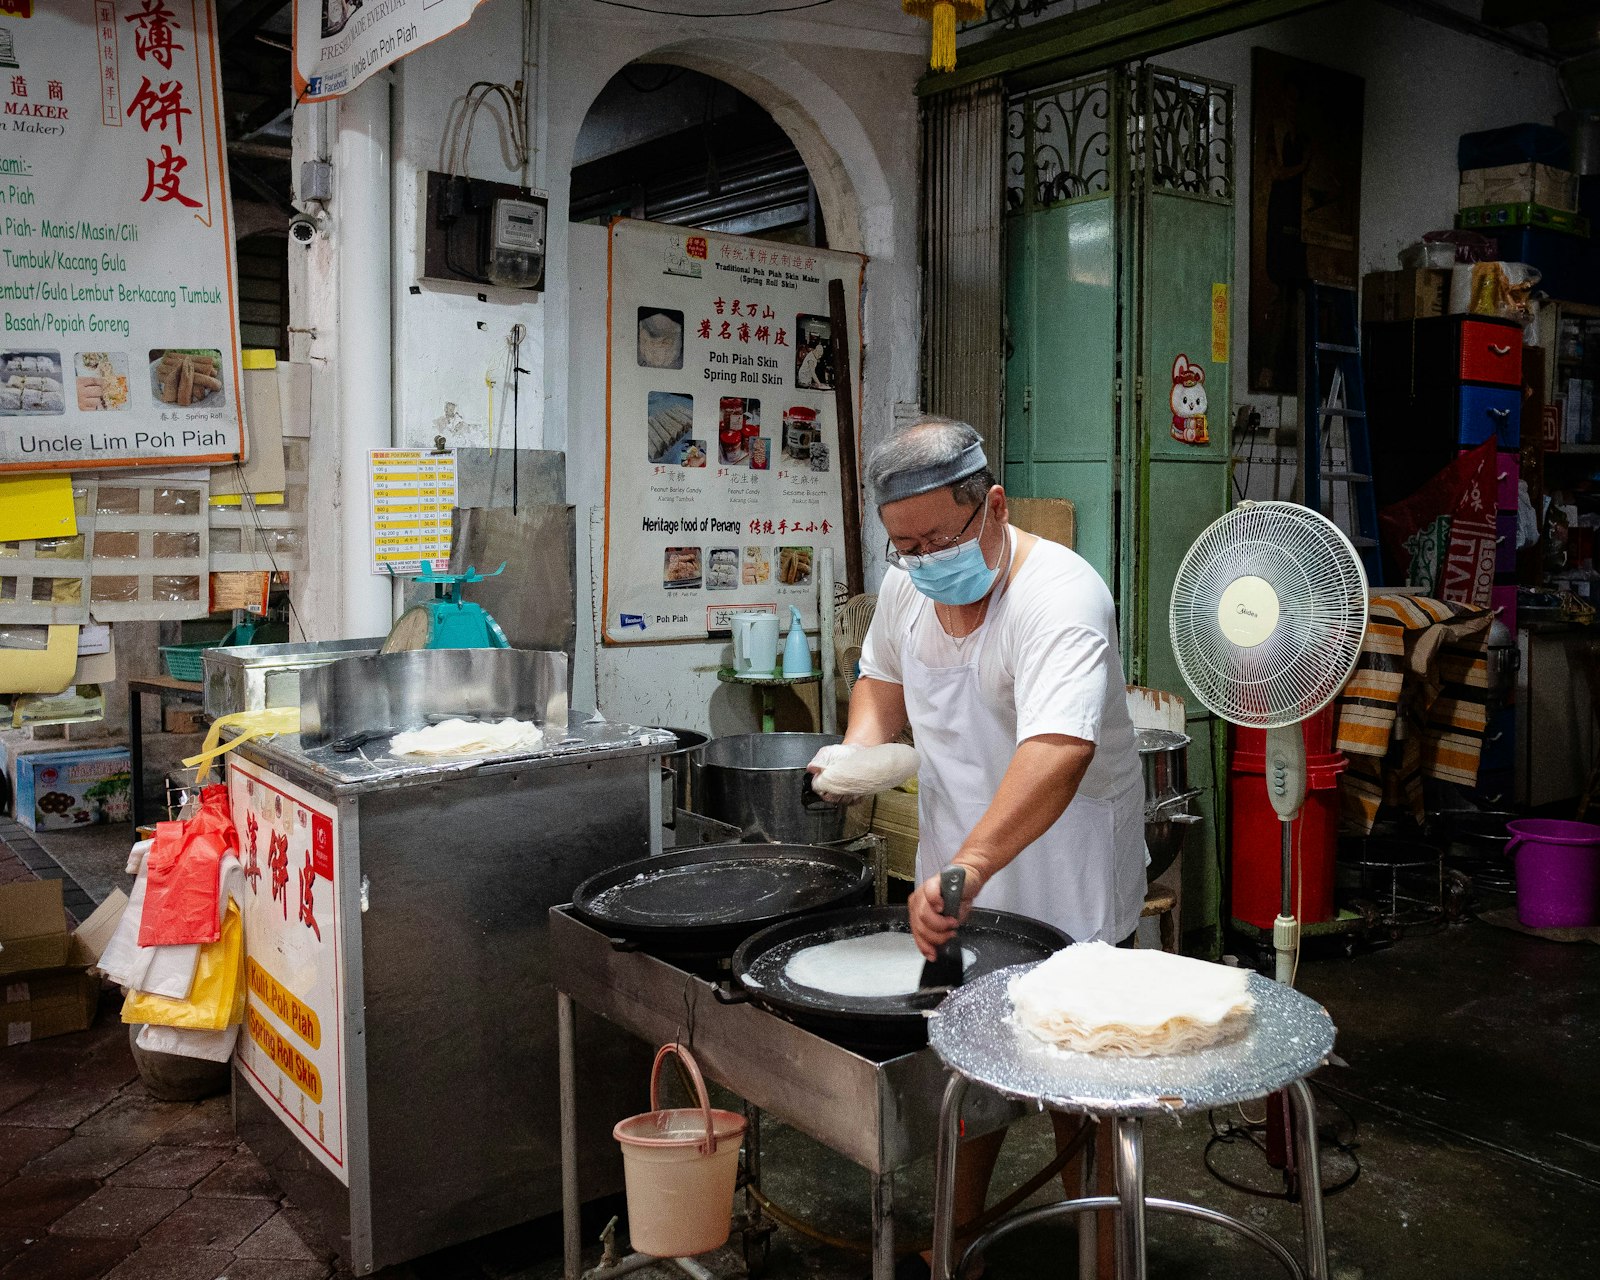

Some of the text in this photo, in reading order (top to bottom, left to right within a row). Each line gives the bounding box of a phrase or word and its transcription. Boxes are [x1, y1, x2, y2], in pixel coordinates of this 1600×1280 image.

[367, 48, 379, 67] Lim
[379, 36, 395, 58] Poh
[396, 22, 419, 47] Piah
[324, 78, 349, 93] Facebook
[4, 101, 69, 120] MAKER
[12, 121, 65, 136] Maker)
[9, 185, 35, 205] Piah
[6, 218, 138, 241] Piah- Manis/Masin/Cili
[3, 249, 127, 275] Tumbuk/Kacang Gula
[715, 263, 820, 283] Traditional Poh Piah Skin Maker
[740, 275, 798, 289] (Spring Roll Skin)
[71, 282, 114, 302] Lembut
[118, 283, 177, 308] Berkacang
[179, 285, 222, 305] Tumbuk
[713, 297, 775, 320] 吉灵万山
[5, 312, 130, 339] Basah/Popiah Goreng
[697, 319, 789, 347] 著名薄饼皮
[709, 351, 778, 368] Poh Piah Skin
[704, 369, 783, 386] Spring Roll Skin
[185, 412, 209, 422] Spring
[209, 412, 223, 420] Roll
[20, 429, 226, 453] Uncle Lim Poh Piah
[729, 473, 759, 485] 花生糖
[650, 485, 702, 495] Peanut Barley Candy
[747, 488, 760, 496] Candy
[642, 516, 741, 535] Heritage food of Penang
[749, 519, 833, 535] 传统手工小食
[656, 615, 670, 623] Poh
[672, 614, 689, 623] Piah
[250, 965, 314, 1042] Kulit Poh Piah
[250, 1008, 318, 1095] Spring Roll Skin
